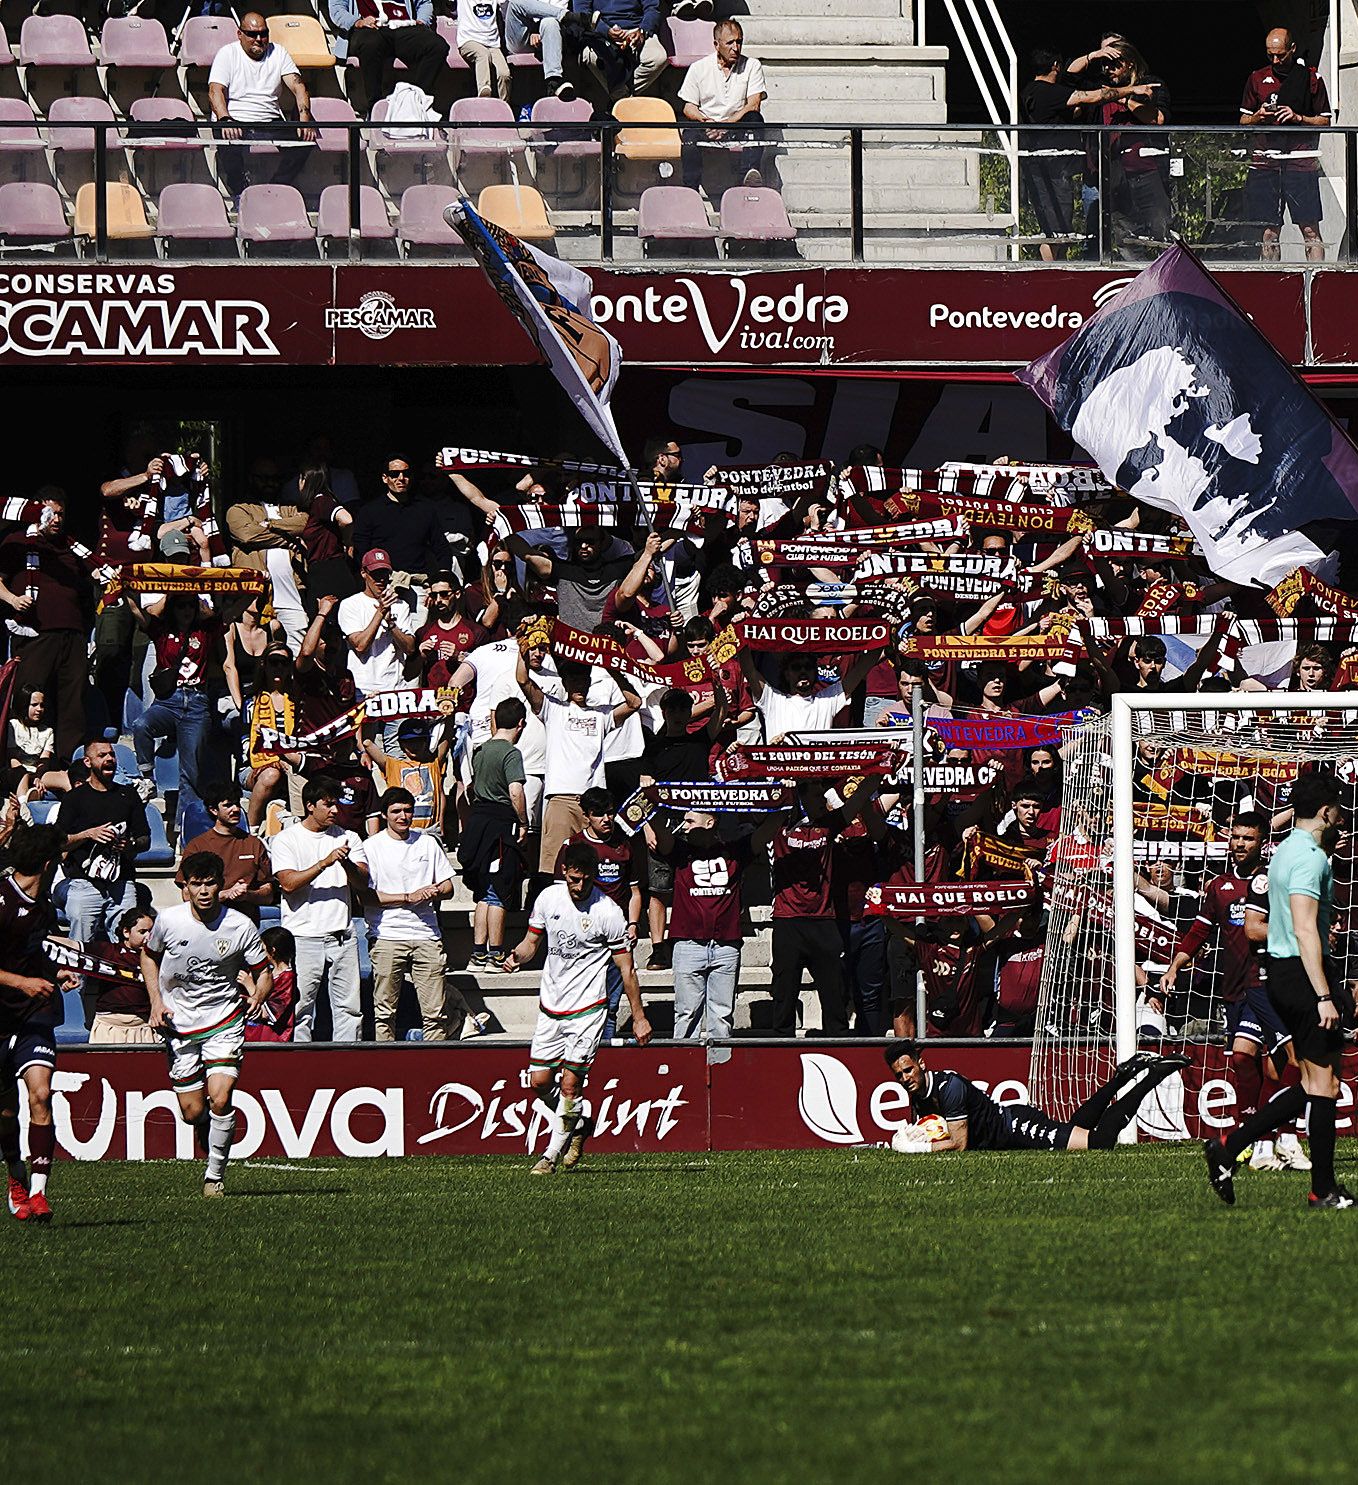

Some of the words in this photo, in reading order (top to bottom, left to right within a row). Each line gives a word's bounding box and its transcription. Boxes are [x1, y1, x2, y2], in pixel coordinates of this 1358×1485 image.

[325, 308, 437, 328] PESCAMAR
[930, 303, 1083, 331] Pontevedra
[0, 299, 281, 356] CAMAR
[719, 464, 827, 483] PONTEVEDRA
[744, 624, 776, 641] HAI
[781, 625, 821, 645] QUE
[825, 625, 887, 641] ROELO
[923, 647, 1005, 660] PONTEVEDRA
[1019, 646, 1045, 658] BOA
[554, 642, 605, 664] NUNCA
[610, 656, 628, 671] SE
[632, 666, 674, 686] RINDE
[752, 752, 767, 761] EL
[769, 751, 811, 762] EQUIPO
[815, 751, 837, 761] DEL
[838, 749, 878, 761] TESÓN
[671, 788, 769, 801] PONTEVEDRA
[895, 891, 926, 904] HAI
[932, 891, 966, 905] QUE
[972, 889, 1028, 903] ROELO
